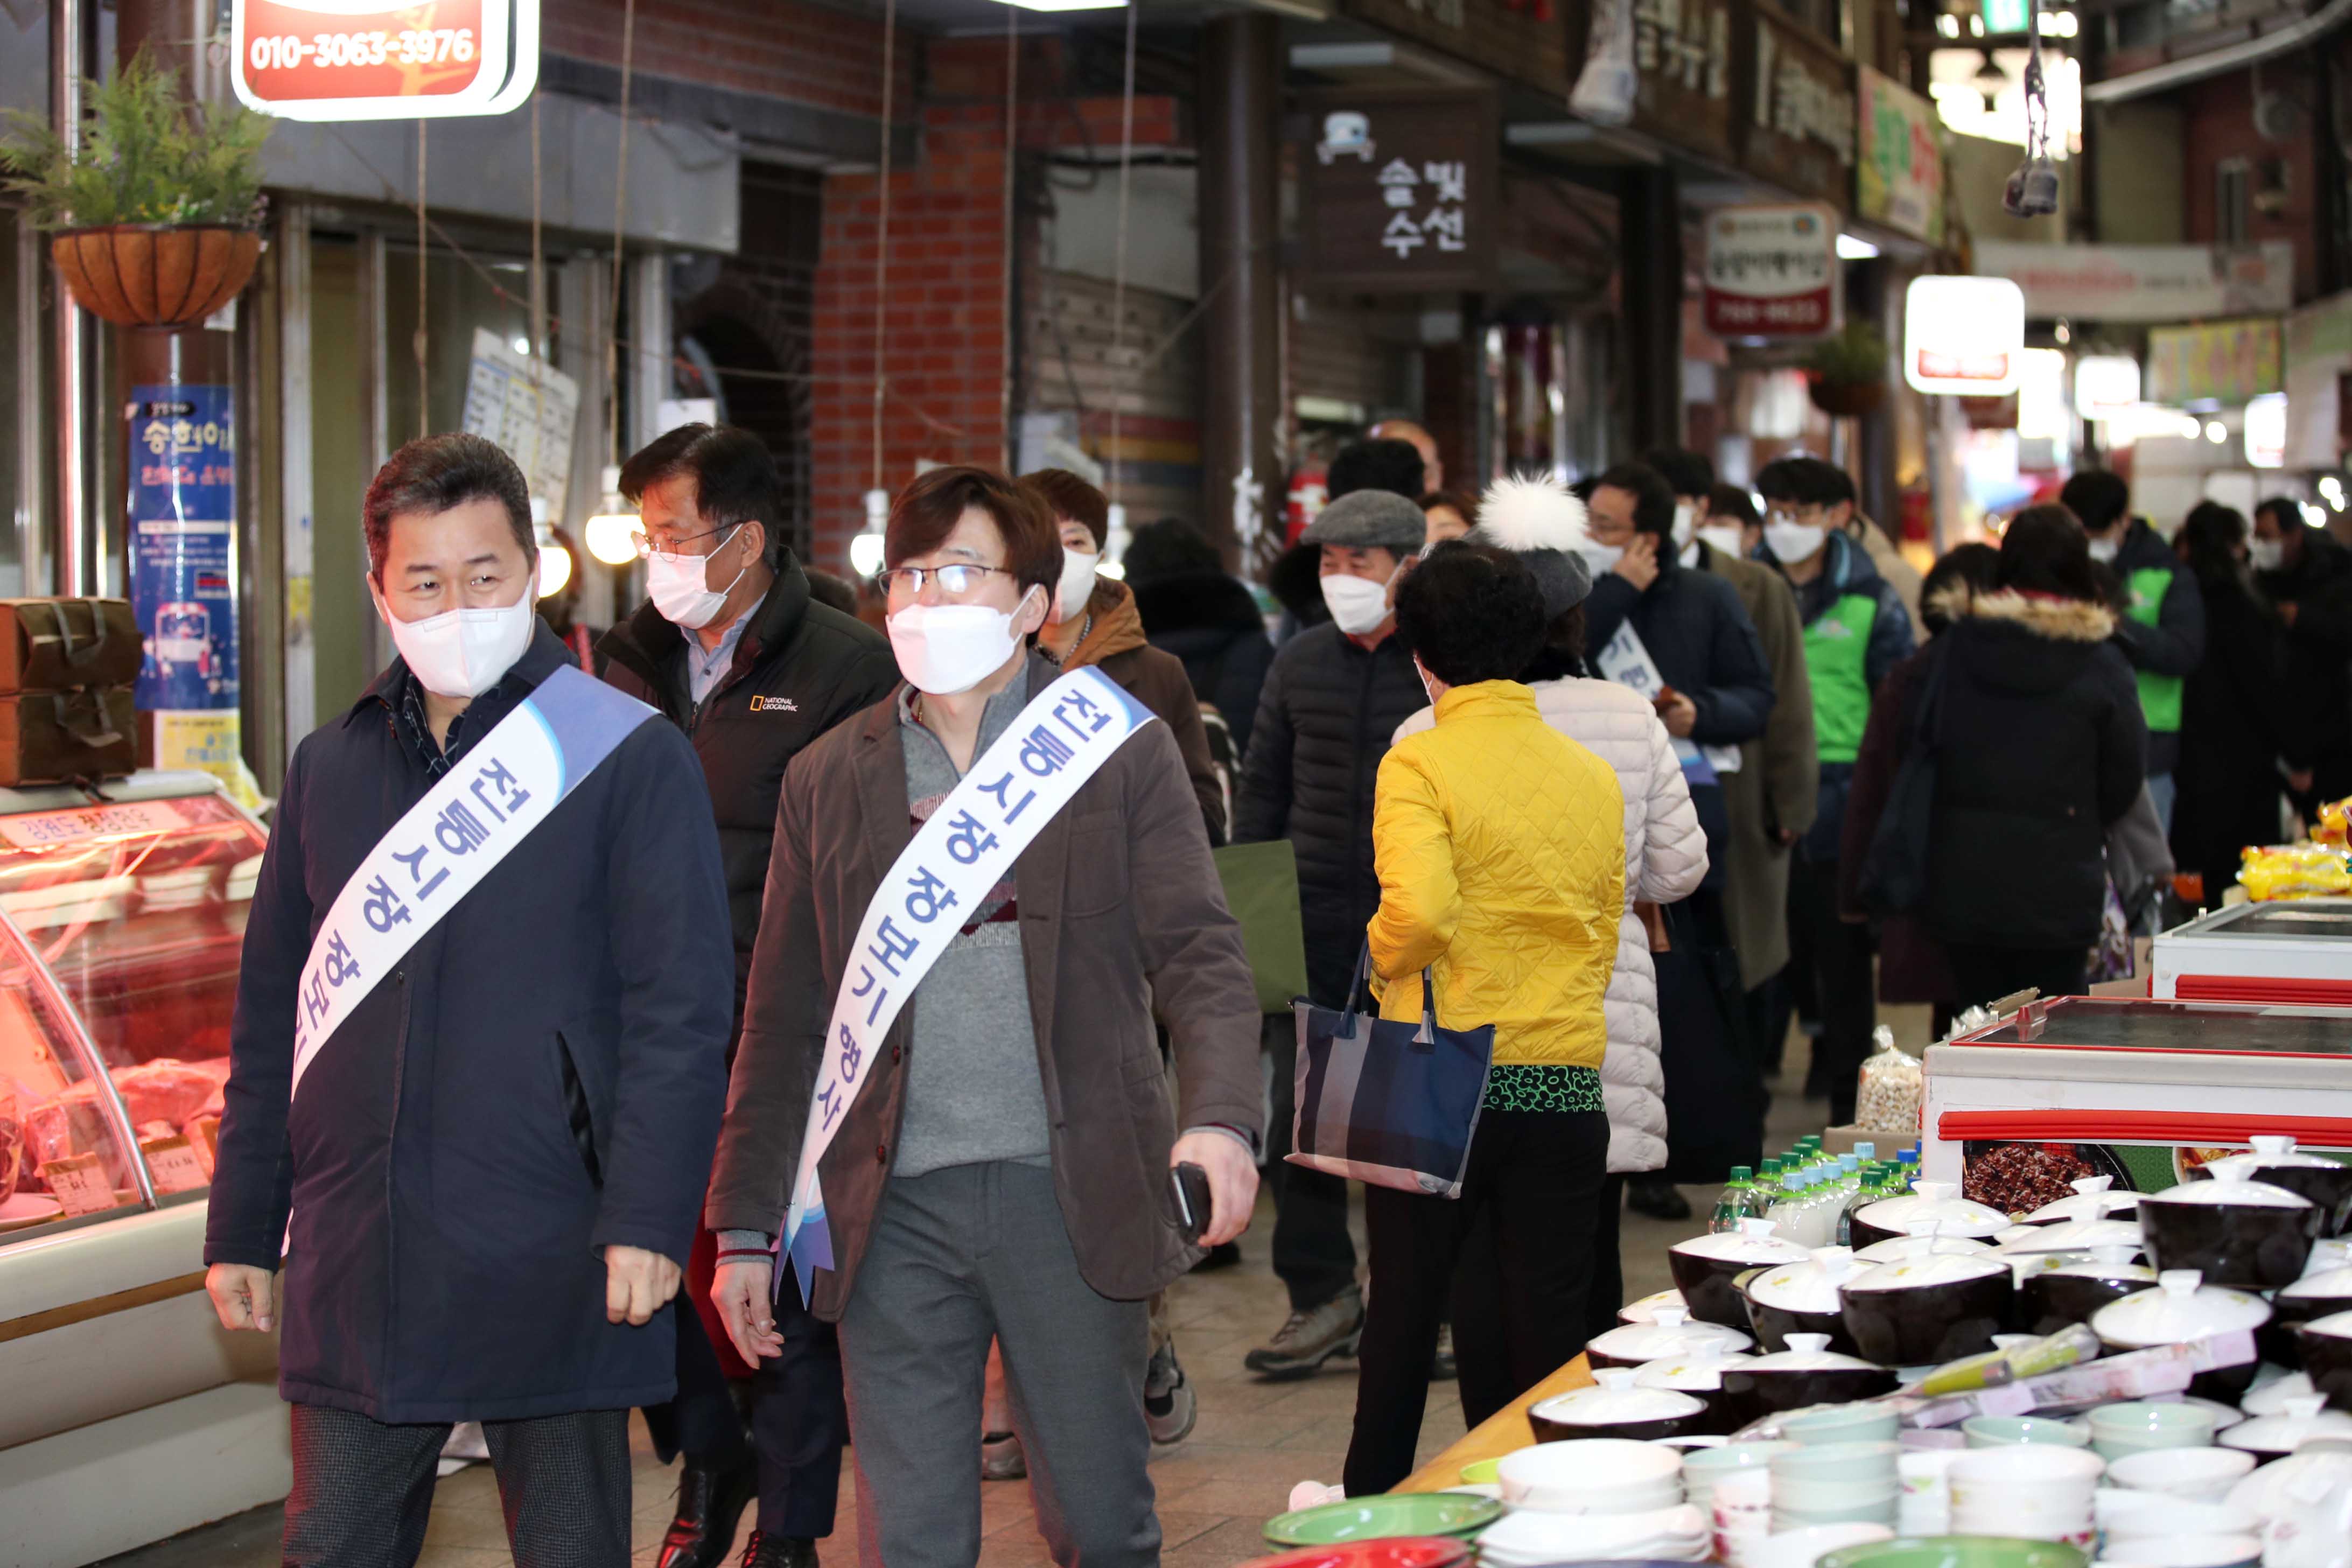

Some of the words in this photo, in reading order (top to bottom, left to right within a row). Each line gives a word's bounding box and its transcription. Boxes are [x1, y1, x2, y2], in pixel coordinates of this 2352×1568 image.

[250, 29, 474, 69] 010-3063-3976
[1381, 207, 1466, 258] 수선
[762, 703, 798, 712] GEOGRAPHIC
[764, 697, 793, 705] NATIONAL
[947, 688, 1114, 865] 전통시장
[365, 757, 531, 934] 전통시장
[852, 865, 960, 1027] 장보기
[817, 1023, 863, 1132] 행사
